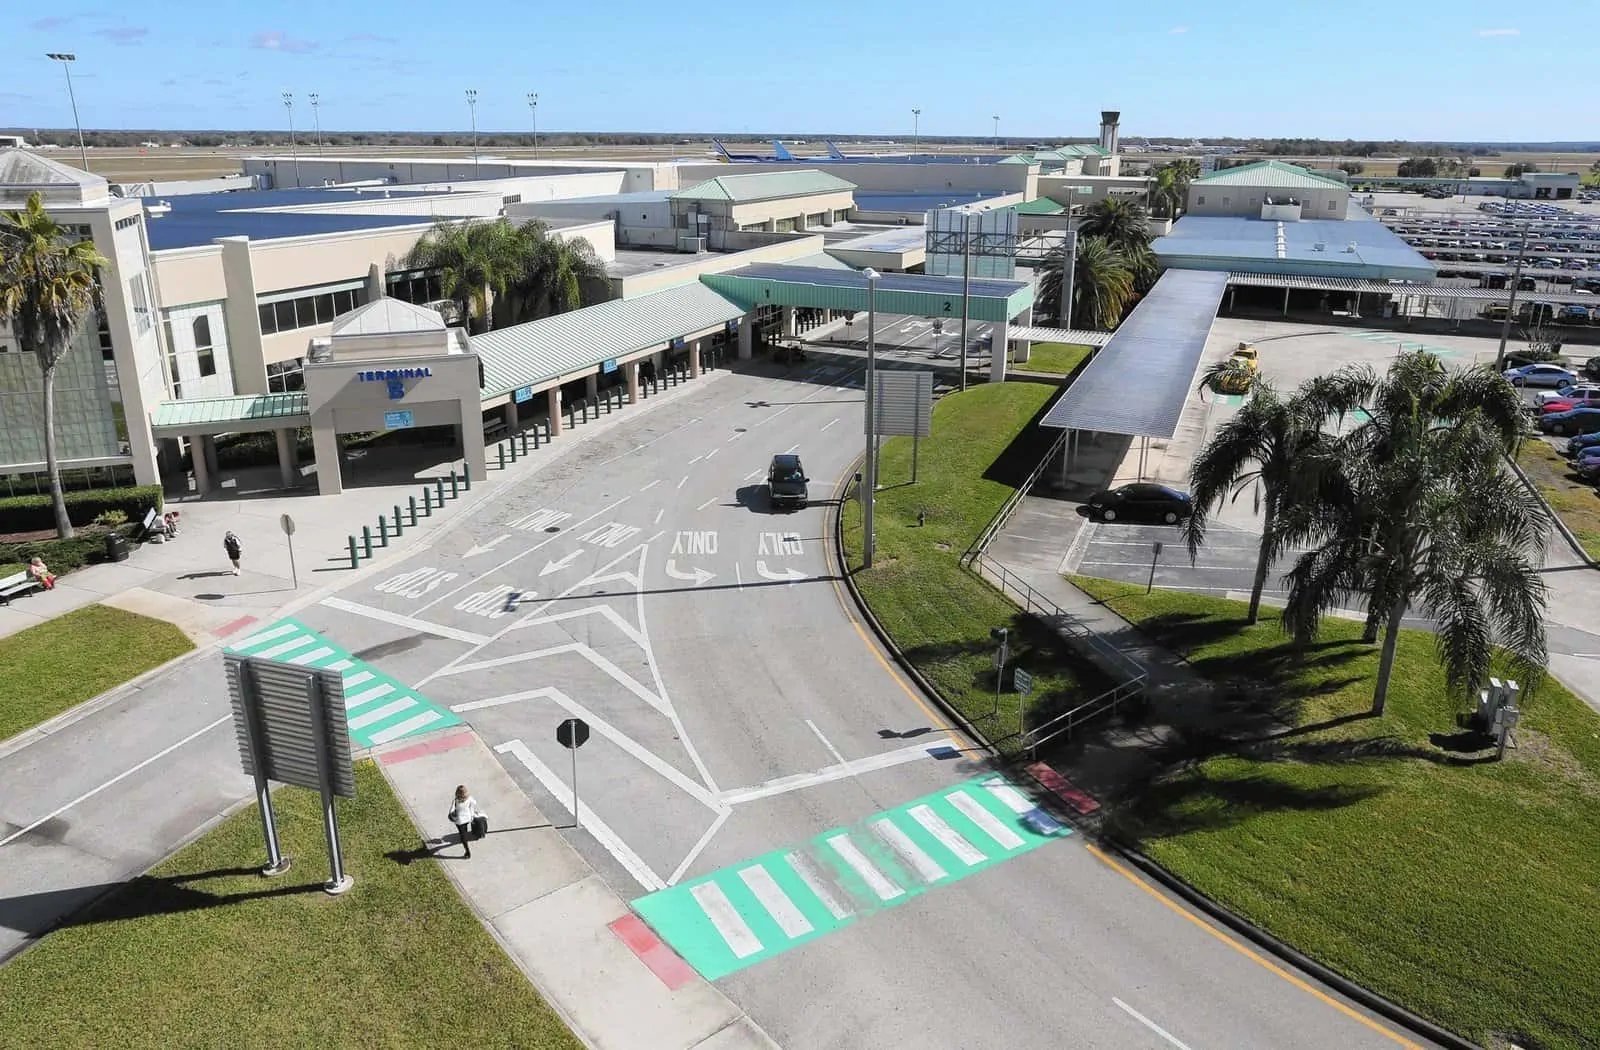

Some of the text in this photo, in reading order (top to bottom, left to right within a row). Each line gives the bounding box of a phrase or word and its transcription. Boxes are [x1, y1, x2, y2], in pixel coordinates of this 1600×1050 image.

[764, 288, 770, 298] 1
[944, 302, 952, 312] 2
[357, 367, 432, 382] TERMINAL
[387, 378, 405, 400] B
[670, 530, 718, 555] ONLY
[758, 531, 804, 555] ONLY
[374, 566, 458, 599] STOP
[454, 584, 539, 619] STOP
